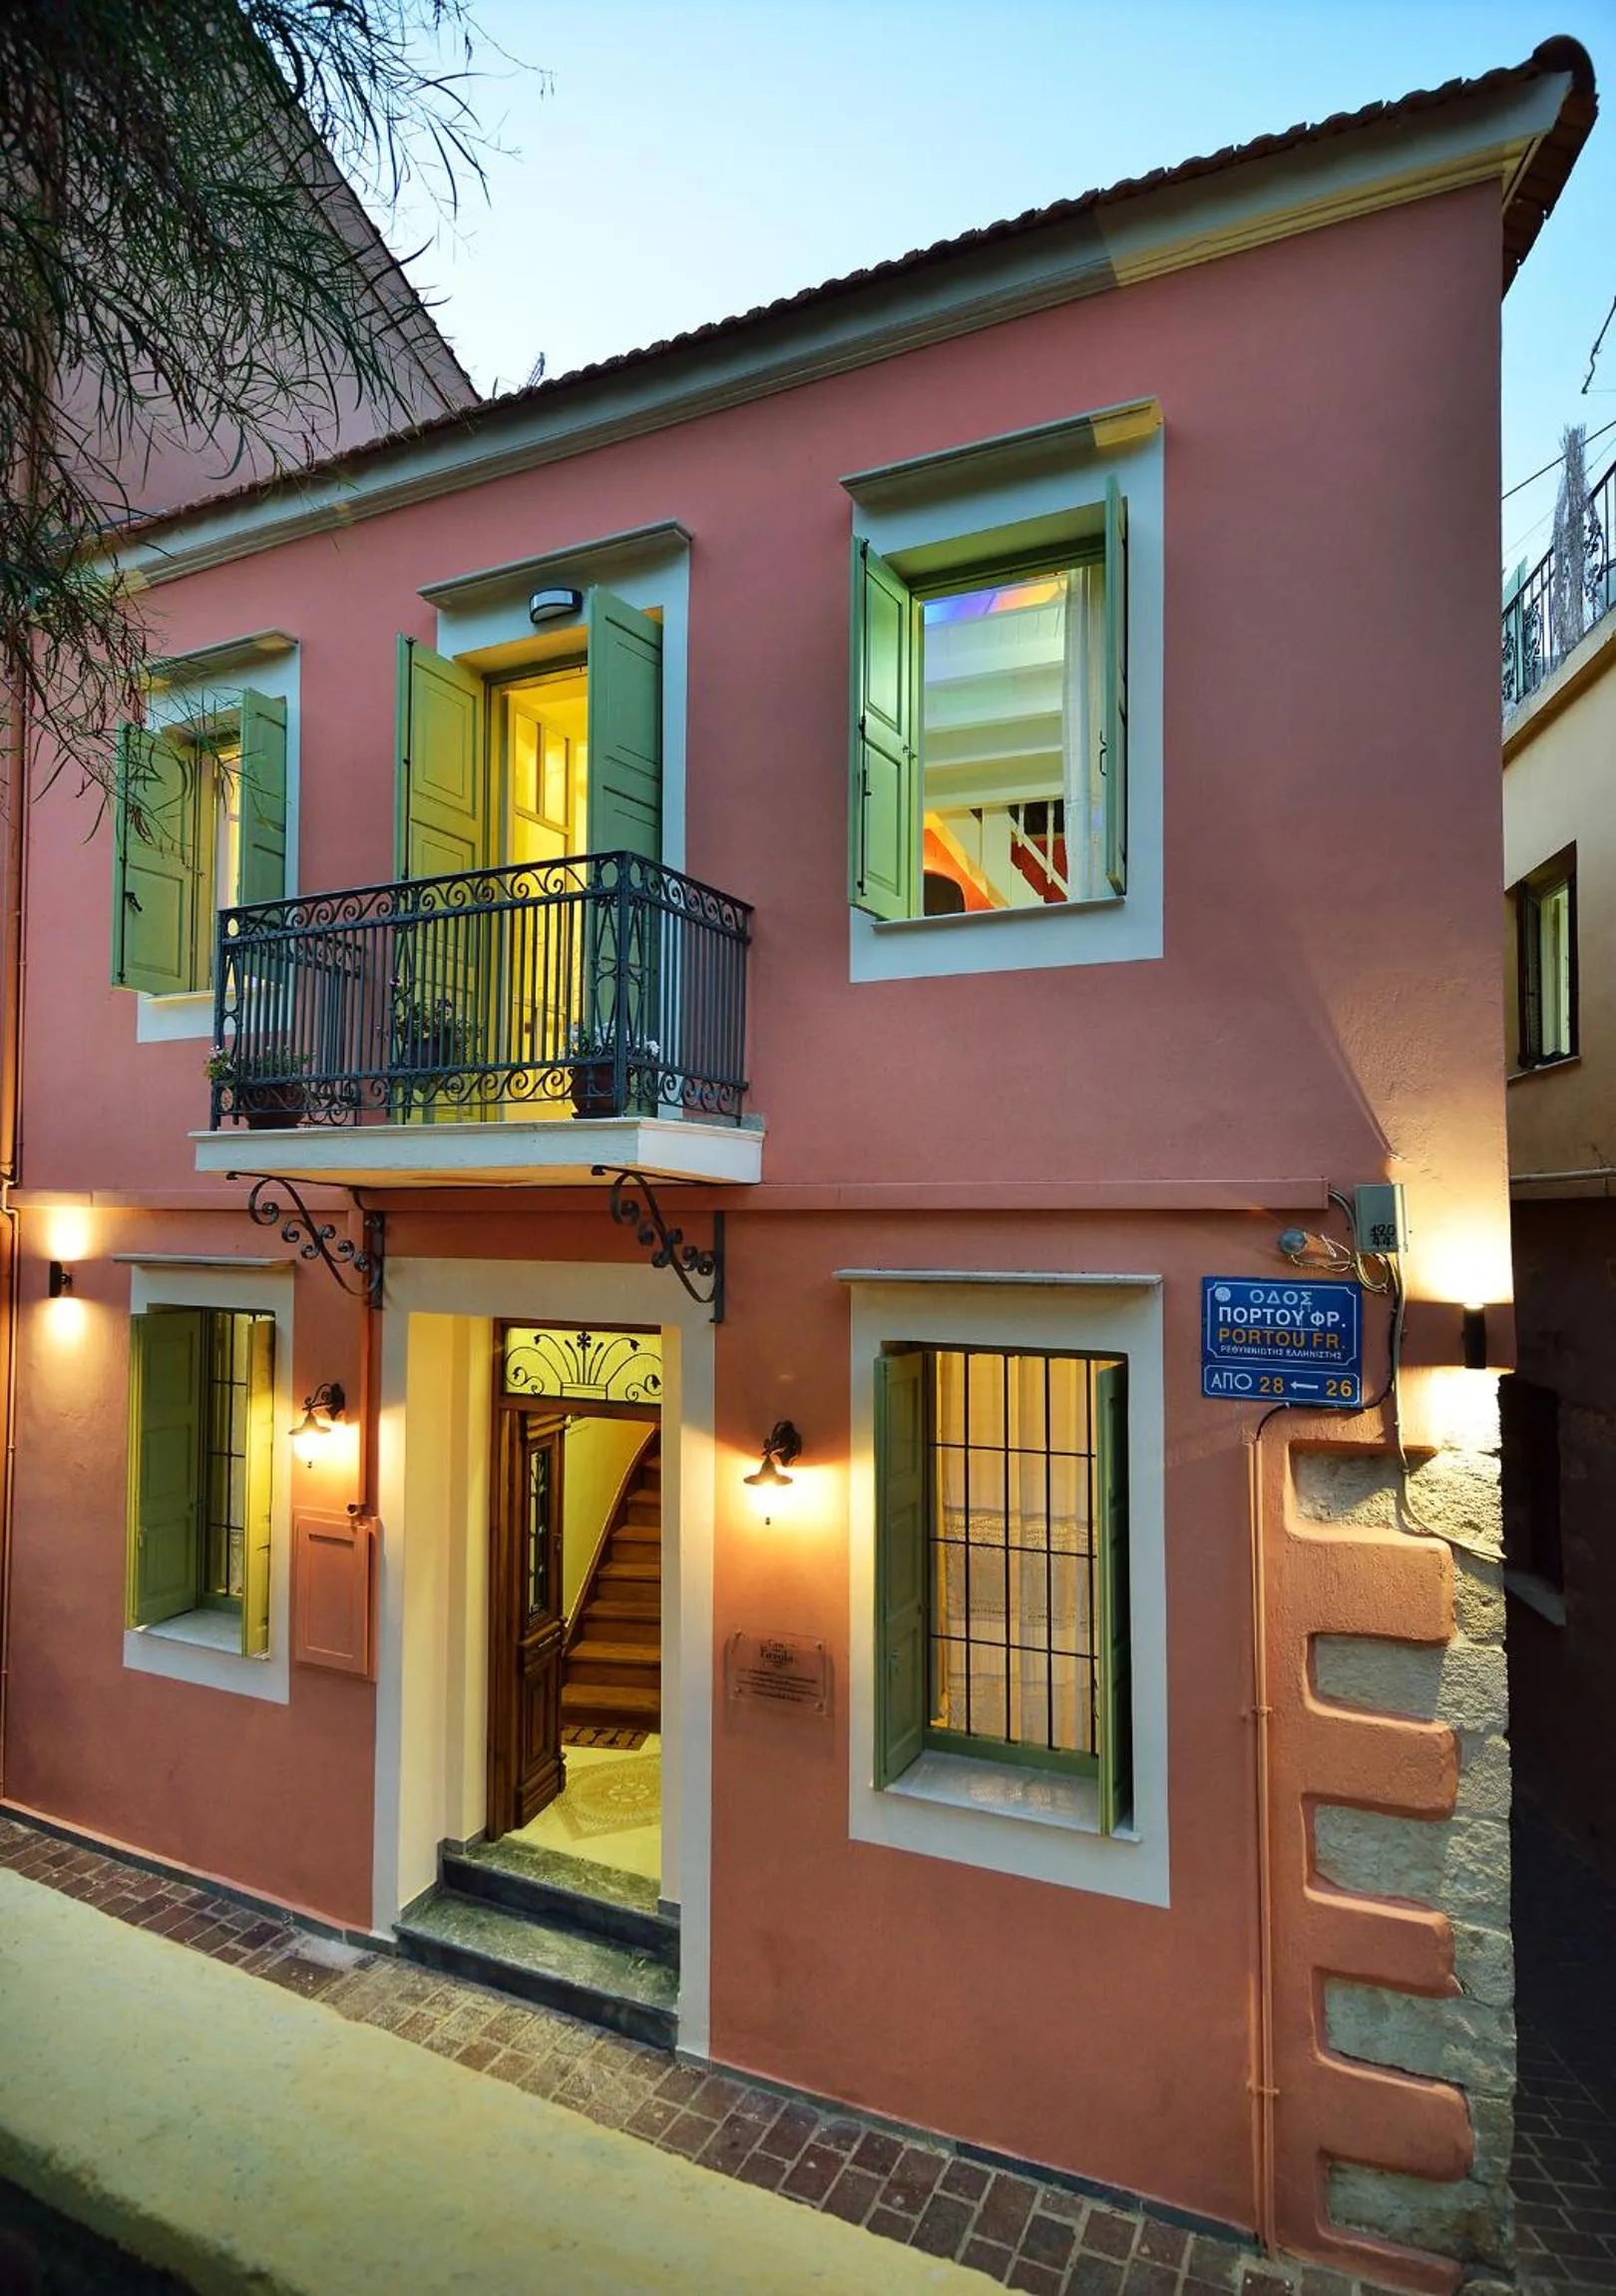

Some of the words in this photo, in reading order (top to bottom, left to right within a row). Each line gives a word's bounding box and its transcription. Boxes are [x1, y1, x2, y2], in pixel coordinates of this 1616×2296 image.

[1249, 1289, 1313, 1305] ΟΔΟΣ
[1218, 1306, 1305, 1326] ΠΟΡΤΟΥ
[1310, 1311, 1347, 1328] ΦΡ.
[1218, 1327, 1305, 1348] PORTOU
[1312, 1332, 1346, 1350] FR.
[1210, 1372, 1253, 1390] ΑΠΟ
[1259, 1376, 1285, 1394] 28
[1326, 1379, 1353, 1397] 26
